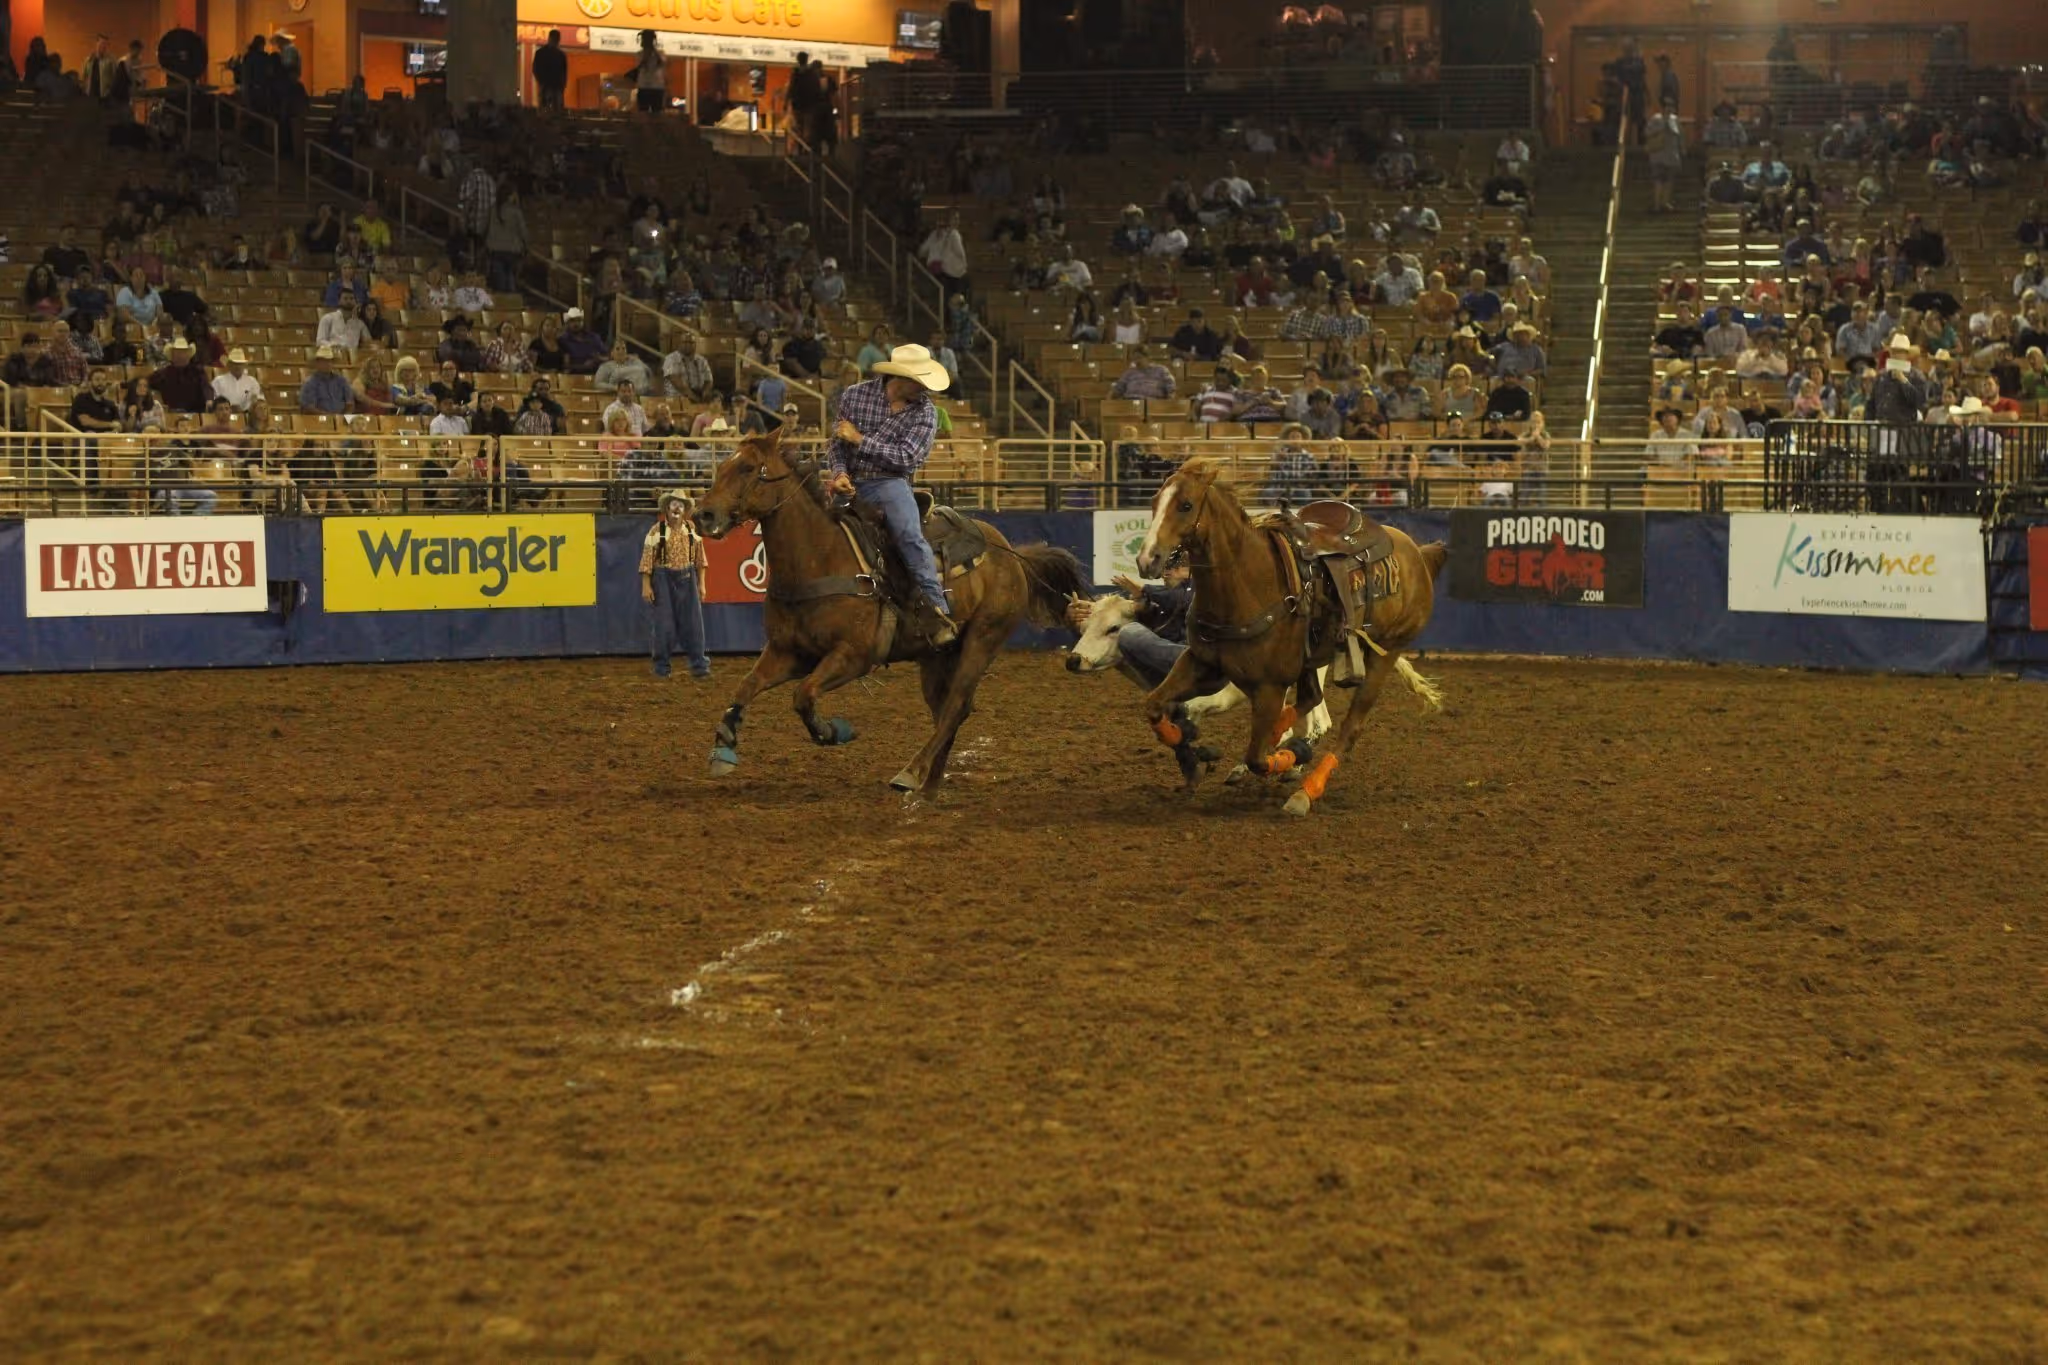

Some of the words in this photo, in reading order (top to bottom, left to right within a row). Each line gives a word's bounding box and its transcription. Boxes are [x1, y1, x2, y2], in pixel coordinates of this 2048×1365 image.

[1115, 519, 1149, 534] WOL
[1487, 516, 1605, 550] PRORODEO
[1821, 530, 1912, 542] EXPERIENCE
[53, 545, 116, 589] LAS
[129, 543, 241, 587] VEGAS
[358, 527, 565, 596] Wrangler
[1774, 522, 1936, 588] Kissimmee
[1580, 590, 1605, 602] .COM
[1882, 584, 1934, 594] FLORIDA
